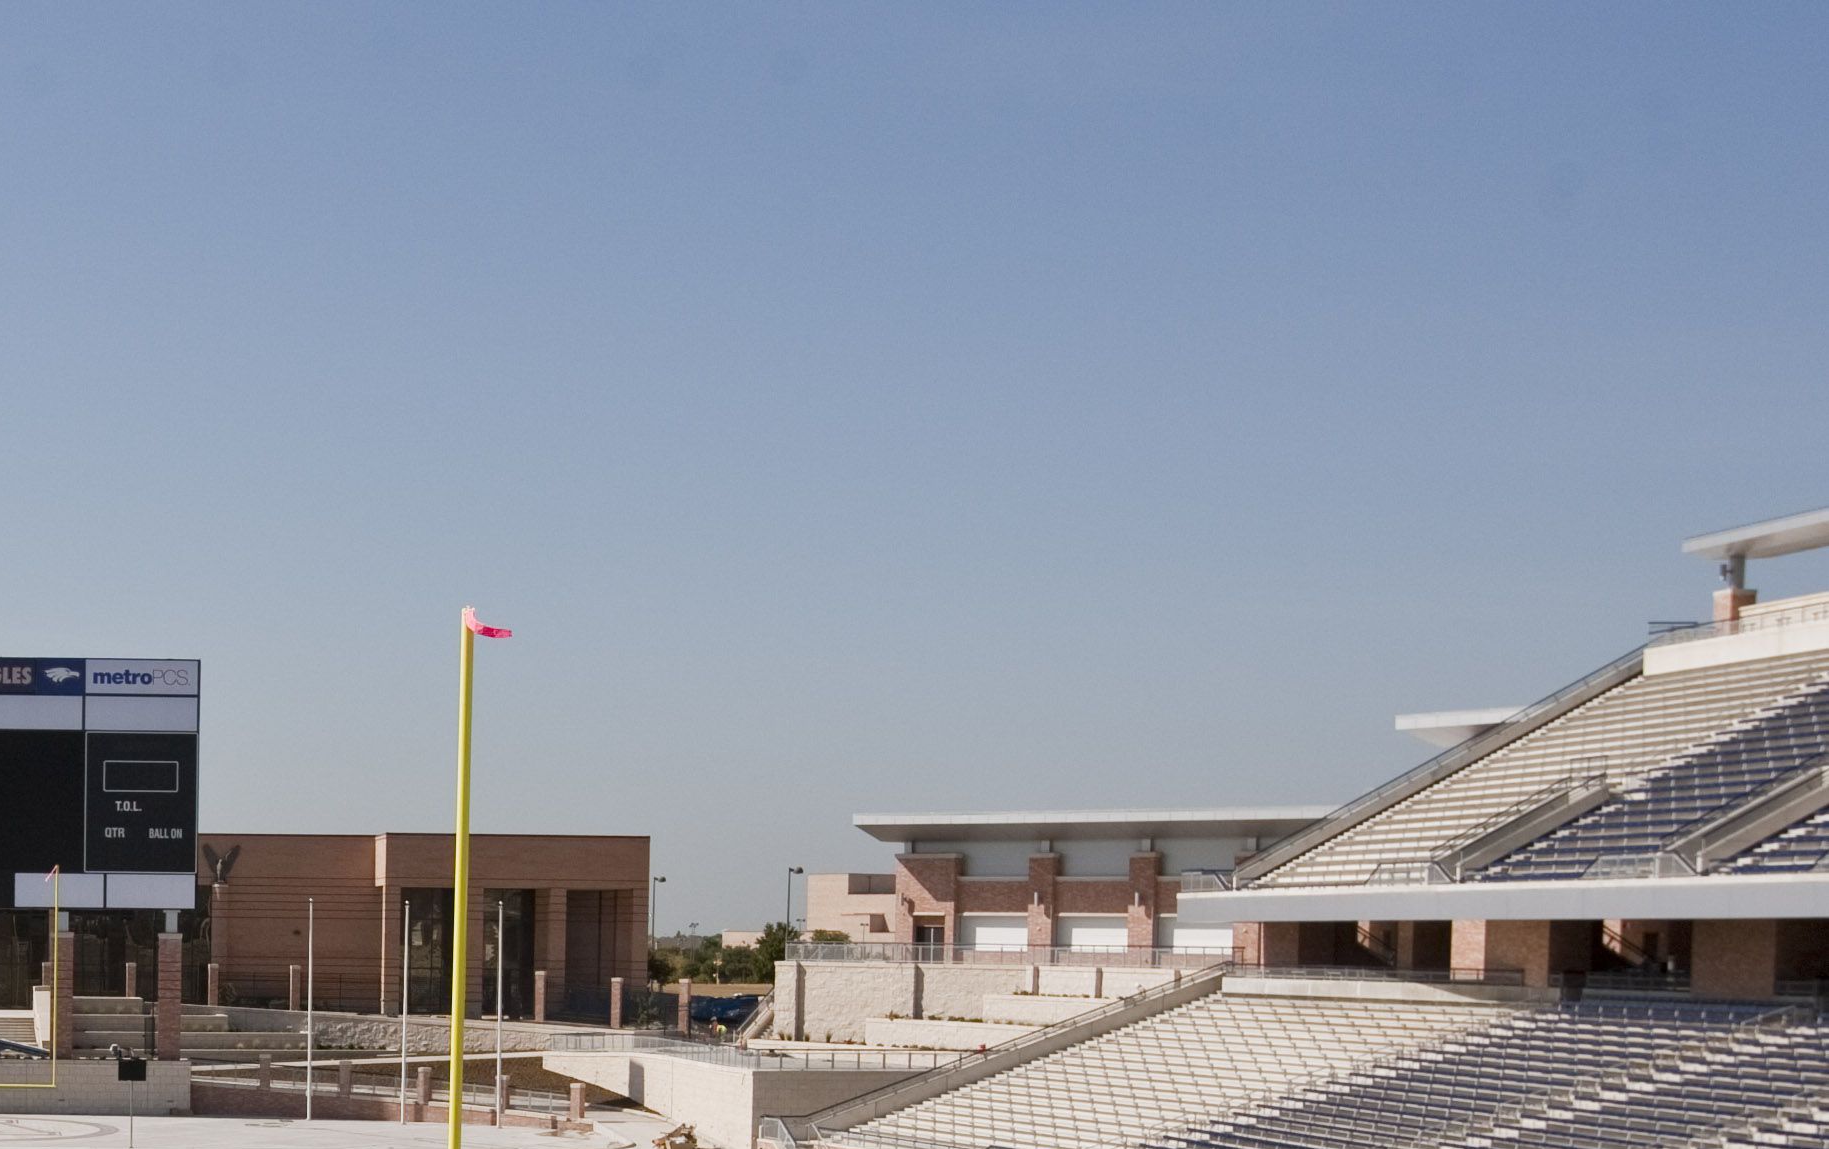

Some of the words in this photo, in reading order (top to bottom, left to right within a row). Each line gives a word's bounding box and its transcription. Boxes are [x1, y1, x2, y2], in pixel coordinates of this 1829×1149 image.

[115, 801, 142, 811] T.O.L.
[105, 827, 126, 838] QTR
[149, 828, 169, 838] BALL
[171, 829, 183, 839] ON
